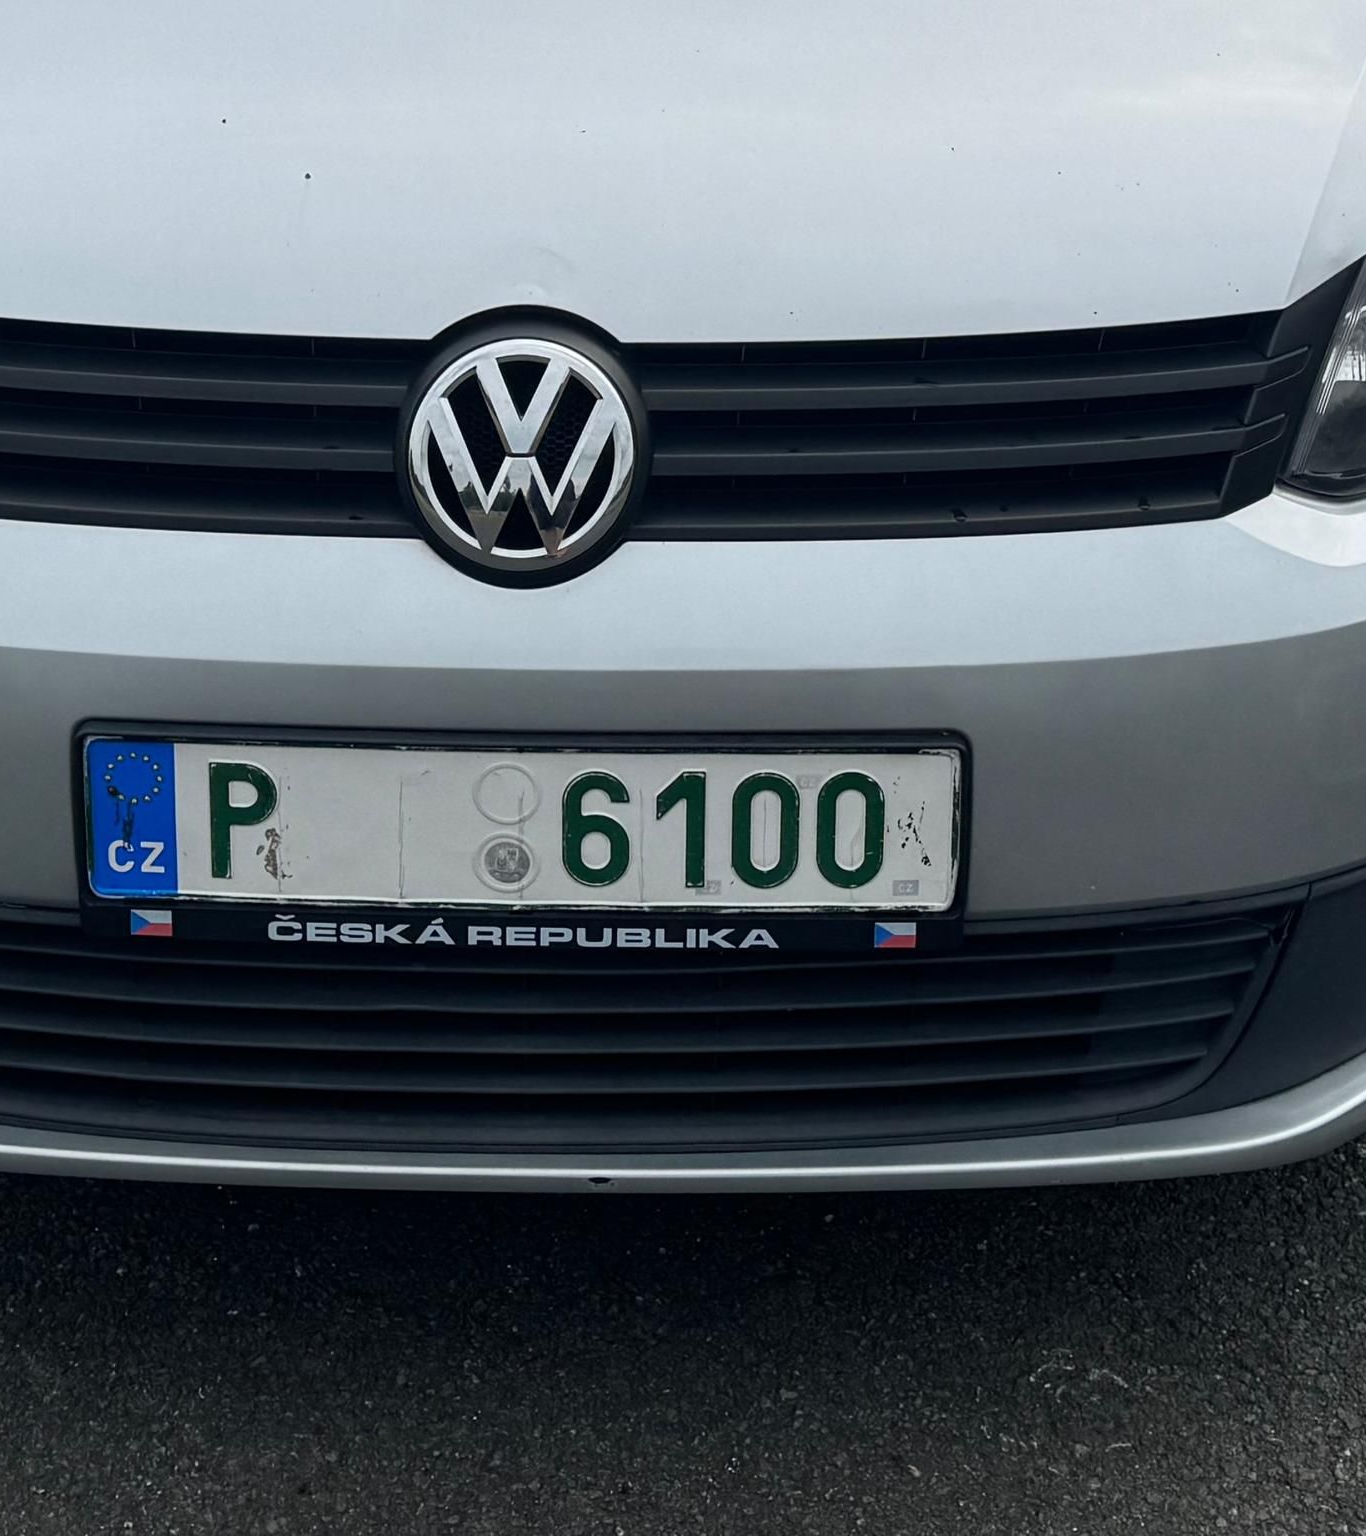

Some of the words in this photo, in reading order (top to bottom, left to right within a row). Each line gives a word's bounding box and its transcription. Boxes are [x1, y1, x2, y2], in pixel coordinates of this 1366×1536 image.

[209, 761, 277, 879] P
[562, 771, 884, 888] 6100
[108, 839, 165, 873] CZ
[267, 914, 456, 945] ČESKÁ
[467, 926, 779, 948] REPUBLIKA
